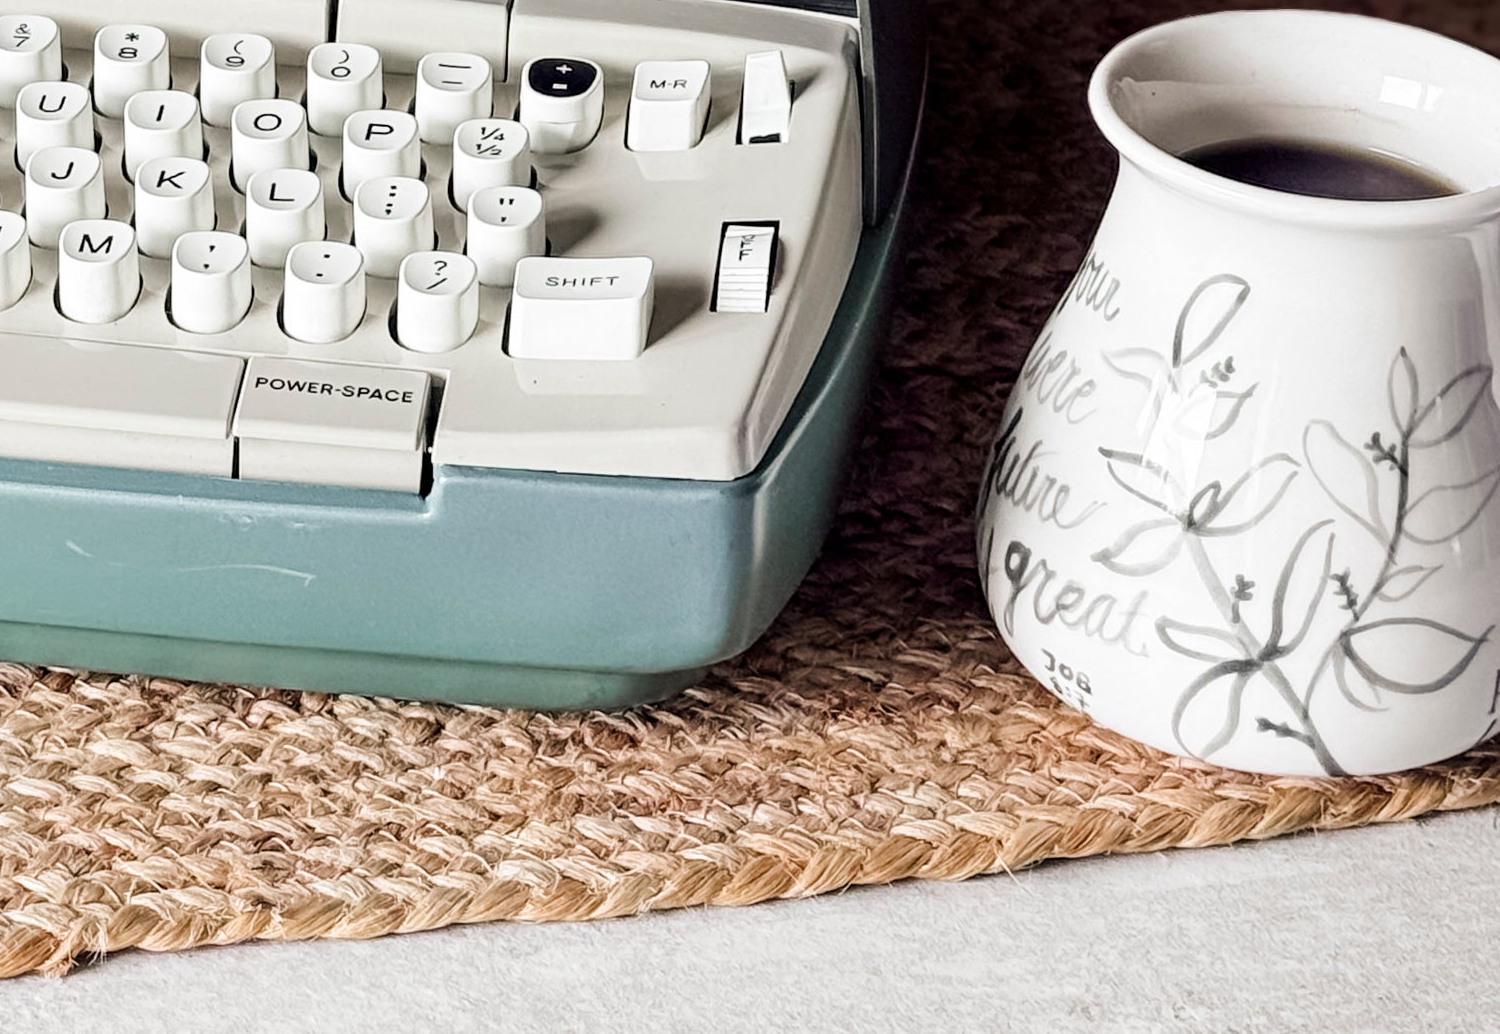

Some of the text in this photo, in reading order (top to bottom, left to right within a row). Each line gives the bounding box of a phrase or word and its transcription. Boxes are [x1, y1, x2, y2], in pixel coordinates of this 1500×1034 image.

[15, 23, 31, 35] &
[11, 35, 31, 48] 7
[118, 46, 138, 59] 8
[38, 94, 67, 113] U
[155, 104, 165, 122] I
[253, 113, 282, 132] O
[364, 123, 395, 141] P
[50, 161, 74, 180] J
[155, 169, 187, 189] K
[268, 182, 296, 203] L
[78, 233, 114, 255] M
[433, 260, 448, 276] ?
[544, 274, 621, 289] SHIFT
[1056, 251, 1122, 322] our
[254, 376, 414, 404] POWER-SPACE
[1003, 539, 1151, 658] great
[1041, 647, 1093, 696] JOB
